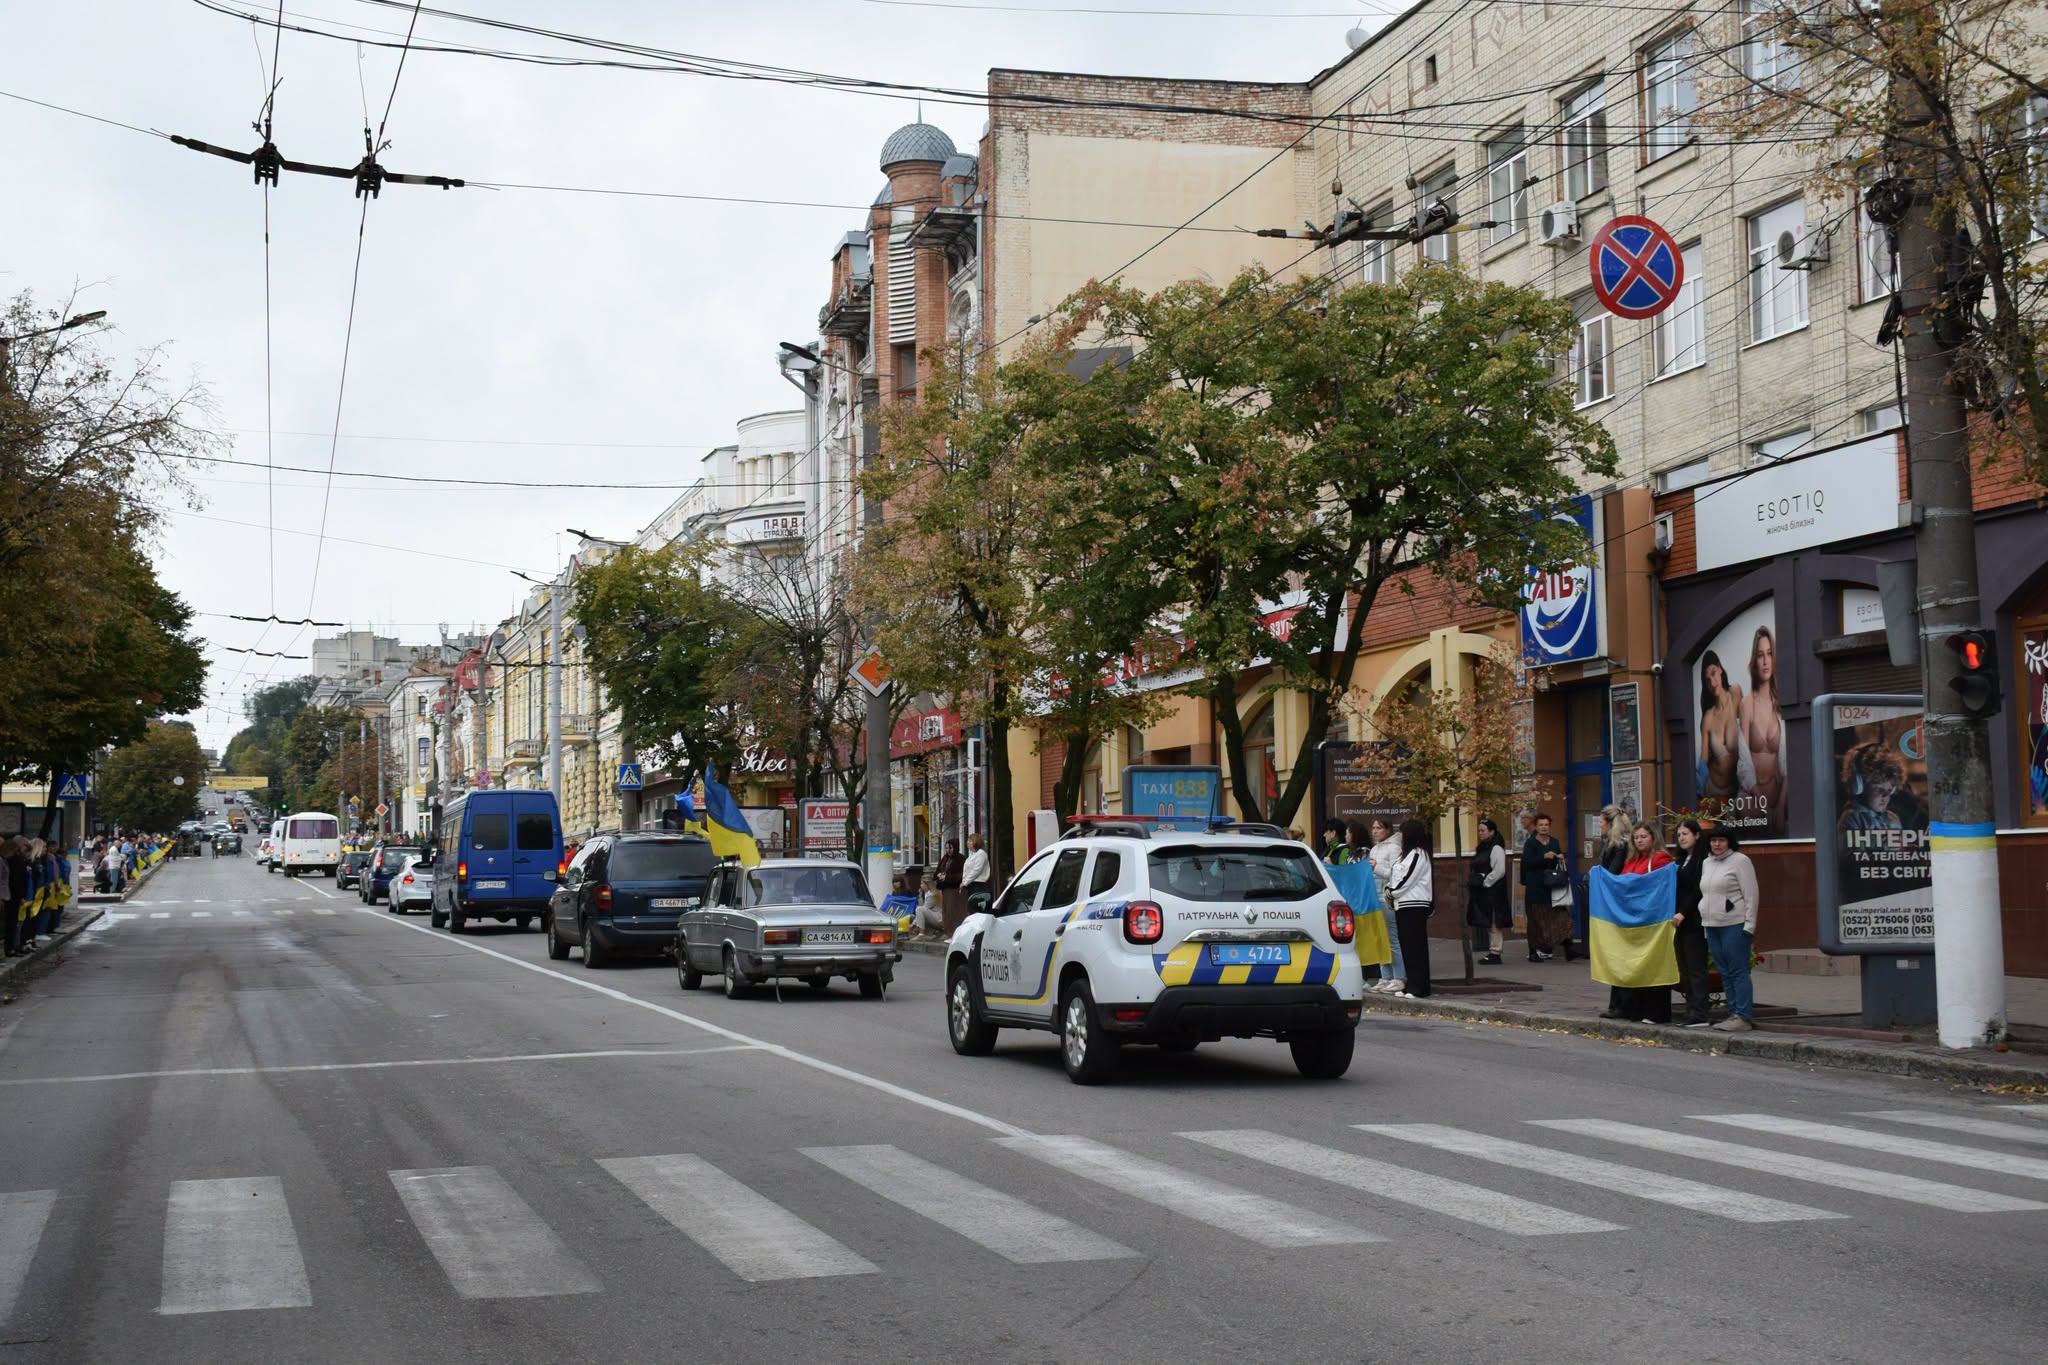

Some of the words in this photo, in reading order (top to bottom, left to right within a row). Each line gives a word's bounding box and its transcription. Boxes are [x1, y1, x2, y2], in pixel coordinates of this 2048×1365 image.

[1757, 489, 1824, 522] ESOTIQ
[1837, 706, 1871, 720] 1024
[1141, 783, 1173, 795] TAXI
[1175, 778, 1209, 798] 838
[1853, 851, 1870, 862] ТА
[1860, 867, 1889, 879] БЕЗ
[1178, 911, 1239, 921] ПАТРУЛЬНА
[1262, 911, 1301, 919] ПОЛІЦІЯ
[1842, 915, 1872, 926] (0522)
[1874, 915, 1909, 924] 276006
[807, 933, 819, 941] CA
[840, 933, 852, 941] AX
[1843, 926, 1868, 938] (067)
[1870, 926, 1909, 936] 2338610
[1248, 946, 1283, 960] 4772
[982, 963, 1009, 981] ПОЛІЦІЯ
